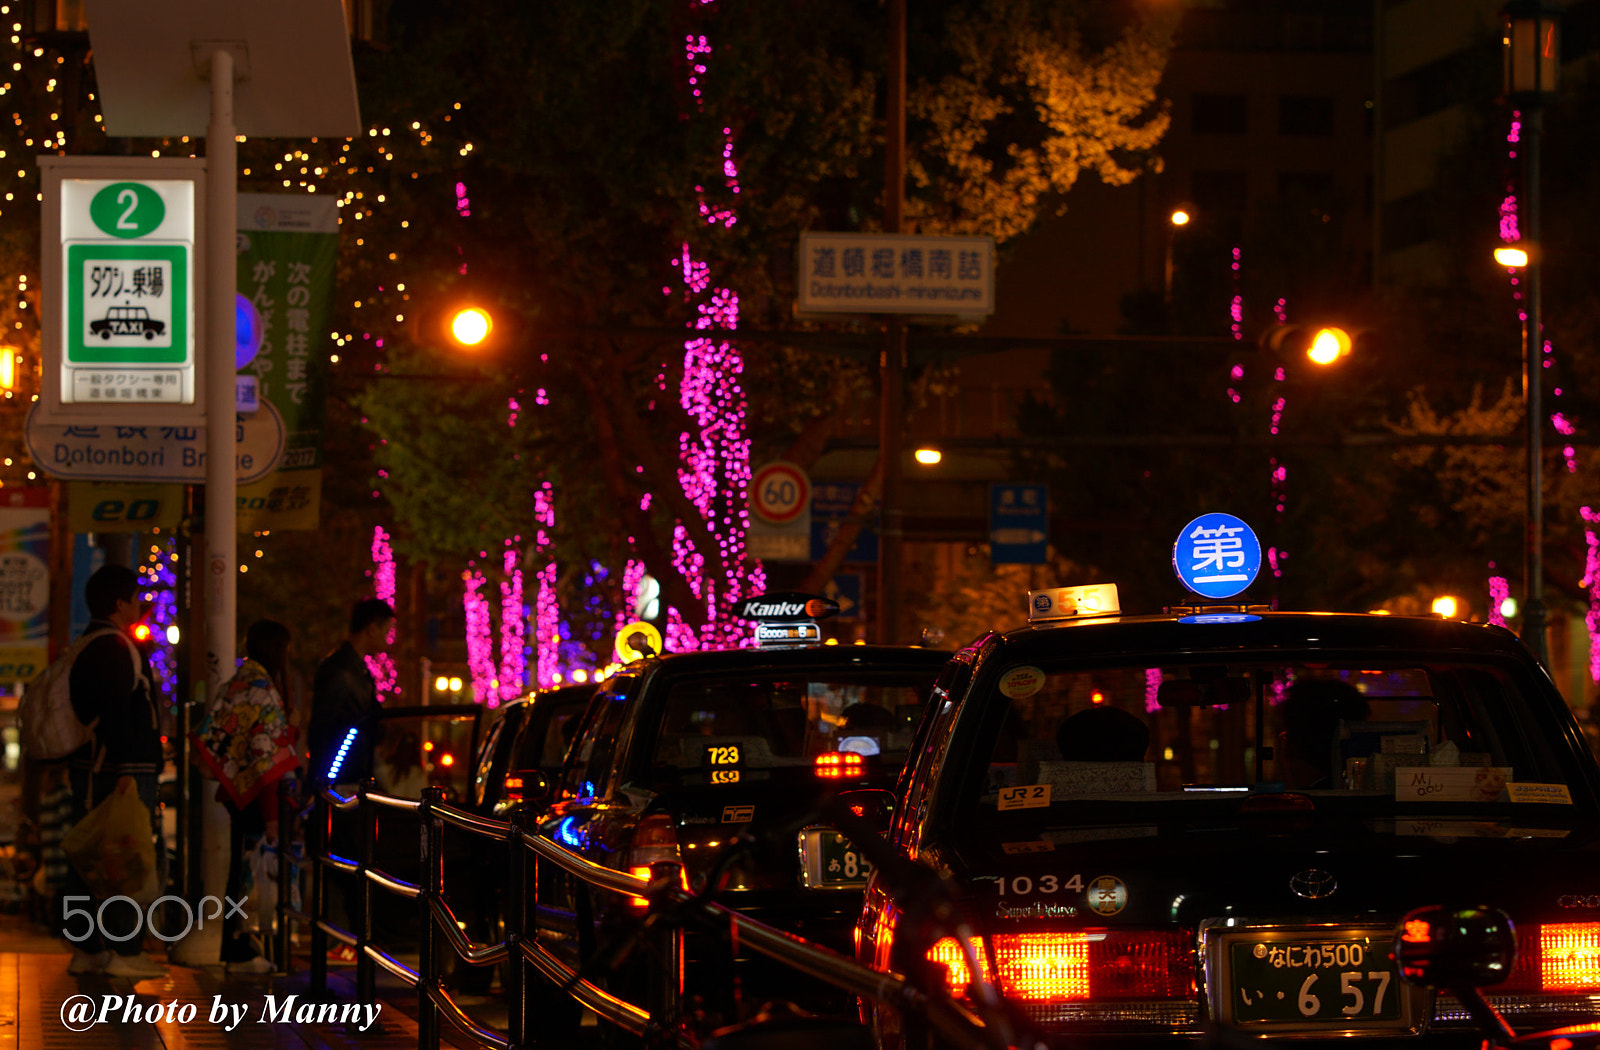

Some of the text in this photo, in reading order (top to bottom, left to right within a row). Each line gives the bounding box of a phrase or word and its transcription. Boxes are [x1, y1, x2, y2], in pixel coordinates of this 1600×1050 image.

[116, 189, 139, 230] 2
[90, 266, 164, 298] タクシー乗場
[109, 321, 144, 333] TAXI
[54, 443, 253, 469] Dotonbori Bre
[764, 481, 796, 505] 60
[92, 499, 159, 521] eo
[1189, 524, 1249, 584] 第一
[742, 602, 805, 617] Kanky
[707, 746, 740, 765] 723
[1003, 787, 1044, 800] JR 2
[828, 858, 841, 872] あ
[994, 873, 1085, 896] 1034
[996, 901, 1033, 922] Super
[1268, 943, 1364, 969] なにわ500
[1240, 987, 1264, 1006] い
